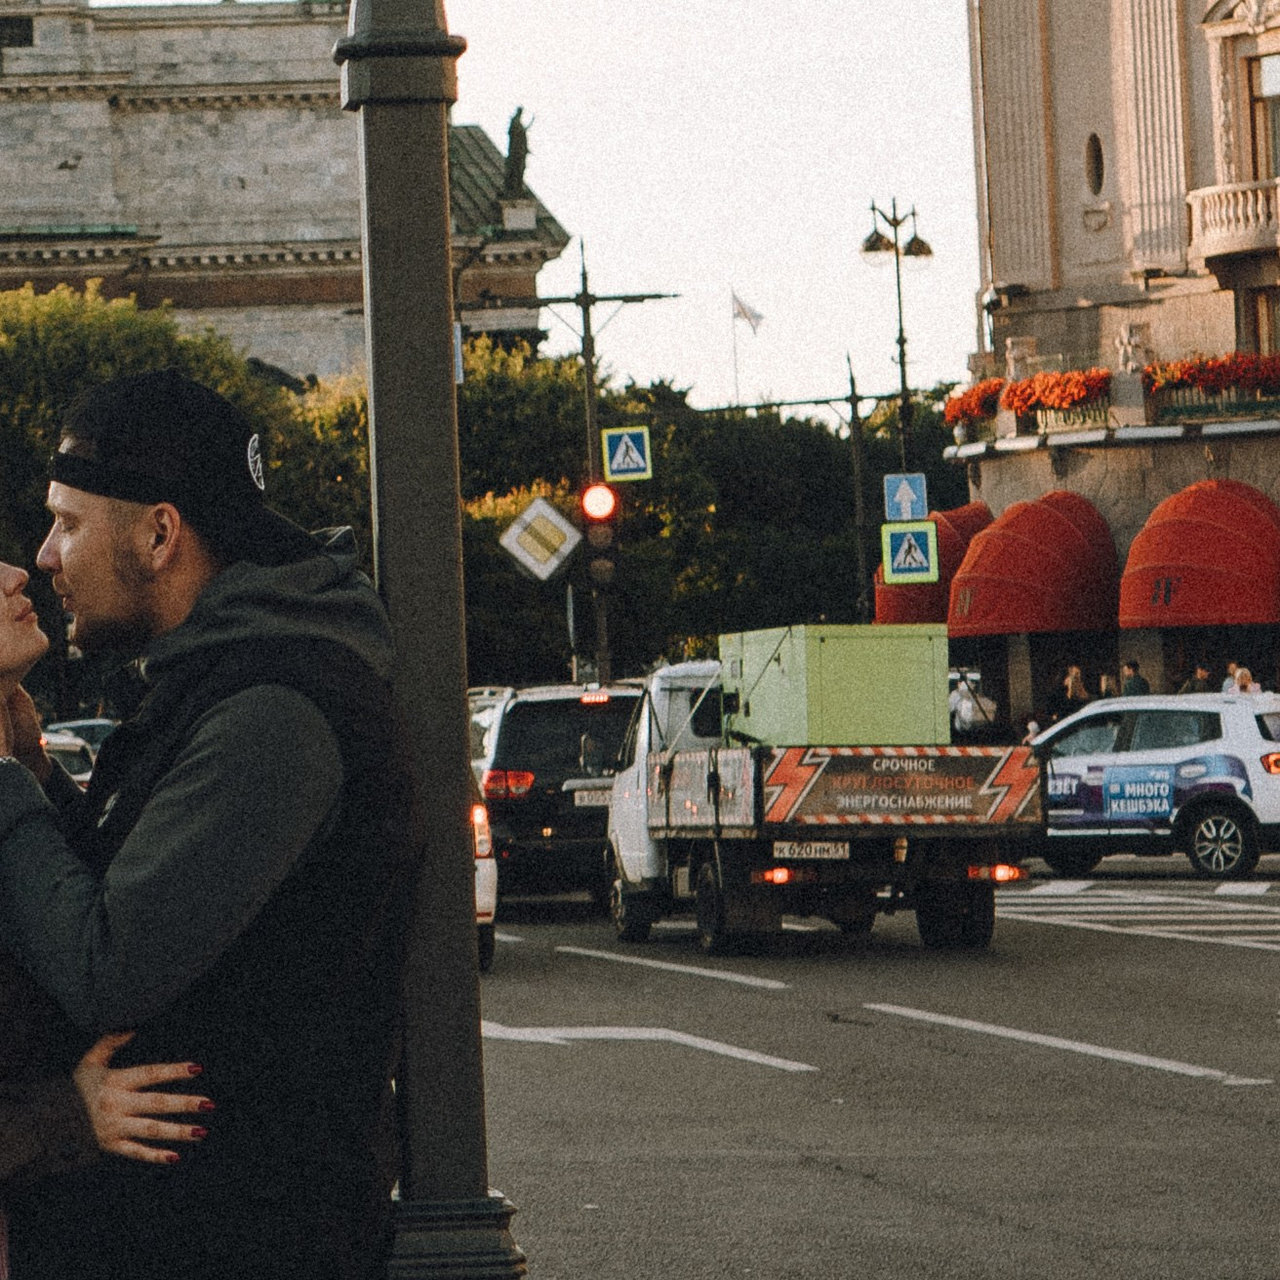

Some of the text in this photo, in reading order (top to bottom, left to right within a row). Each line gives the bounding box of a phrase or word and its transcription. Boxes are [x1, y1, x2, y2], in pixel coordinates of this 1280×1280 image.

[872, 758, 935, 771] СРОЧНОЕ
[831, 775, 974, 790] КРУГЛОСУТОЧНОЕ
[1124, 782, 1169, 797] МНОГО
[835, 794, 972, 809] ЭНЕРГОСНАБЖЕНИЕ
[1111, 799, 1170, 813] КЕШБЭКА
